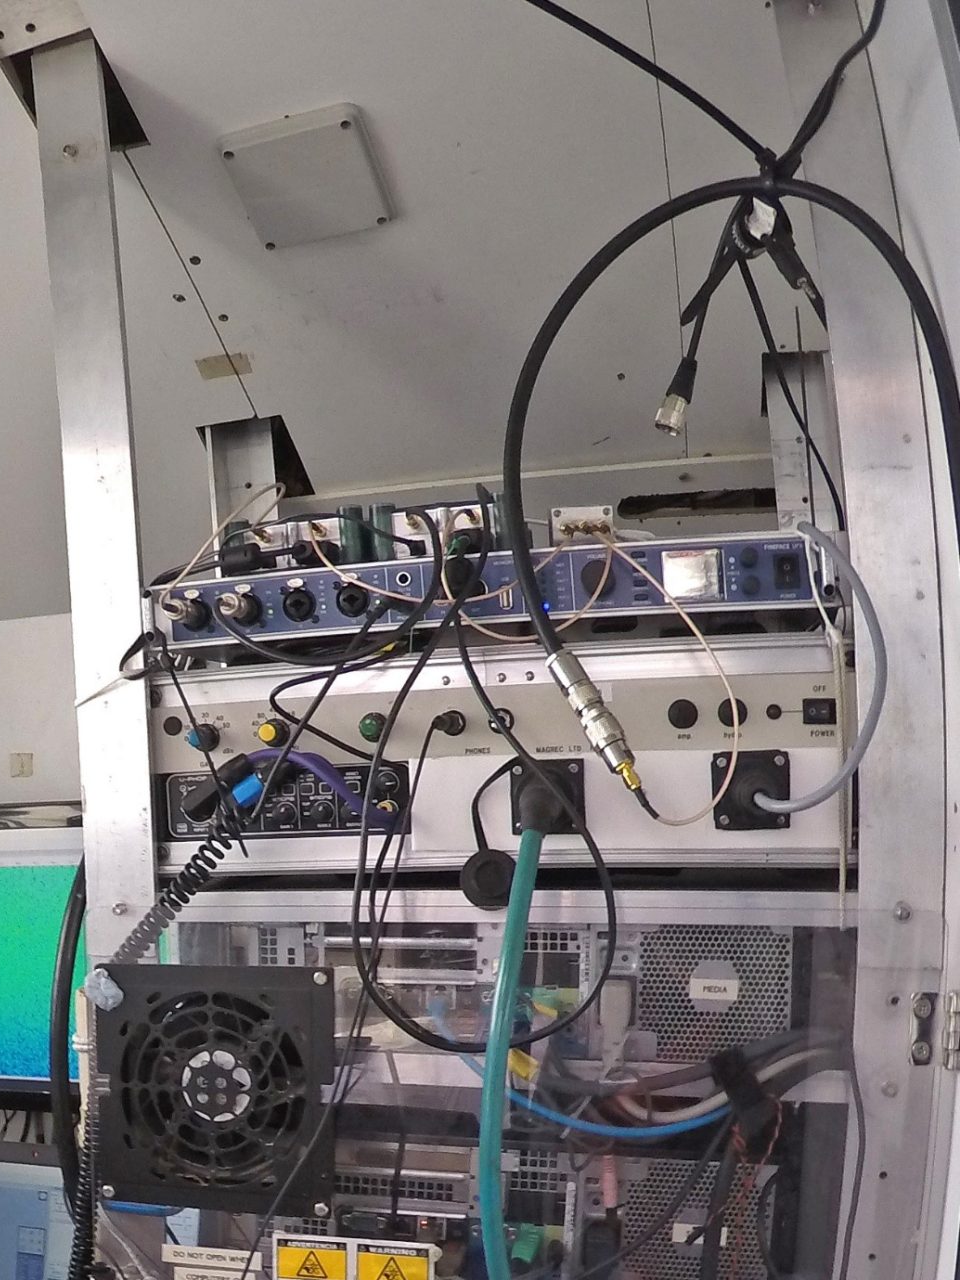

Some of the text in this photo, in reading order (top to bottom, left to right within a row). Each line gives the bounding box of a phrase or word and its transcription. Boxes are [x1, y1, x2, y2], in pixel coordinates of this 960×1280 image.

[812, 685, 827, 693] OFF
[677, 733, 692, 741] amp
[809, 729, 836, 738] POWER
[464, 746, 492, 755] PHONES
[568, 744, 583, 753] LTD
[702, 985, 728, 994] MEDIA
[172, 1249, 186, 1259] DO
[187, 1251, 205, 1260] NOT
[205, 1253, 227, 1263] OPEN
[368, 1246, 418, 1257] WARNING
